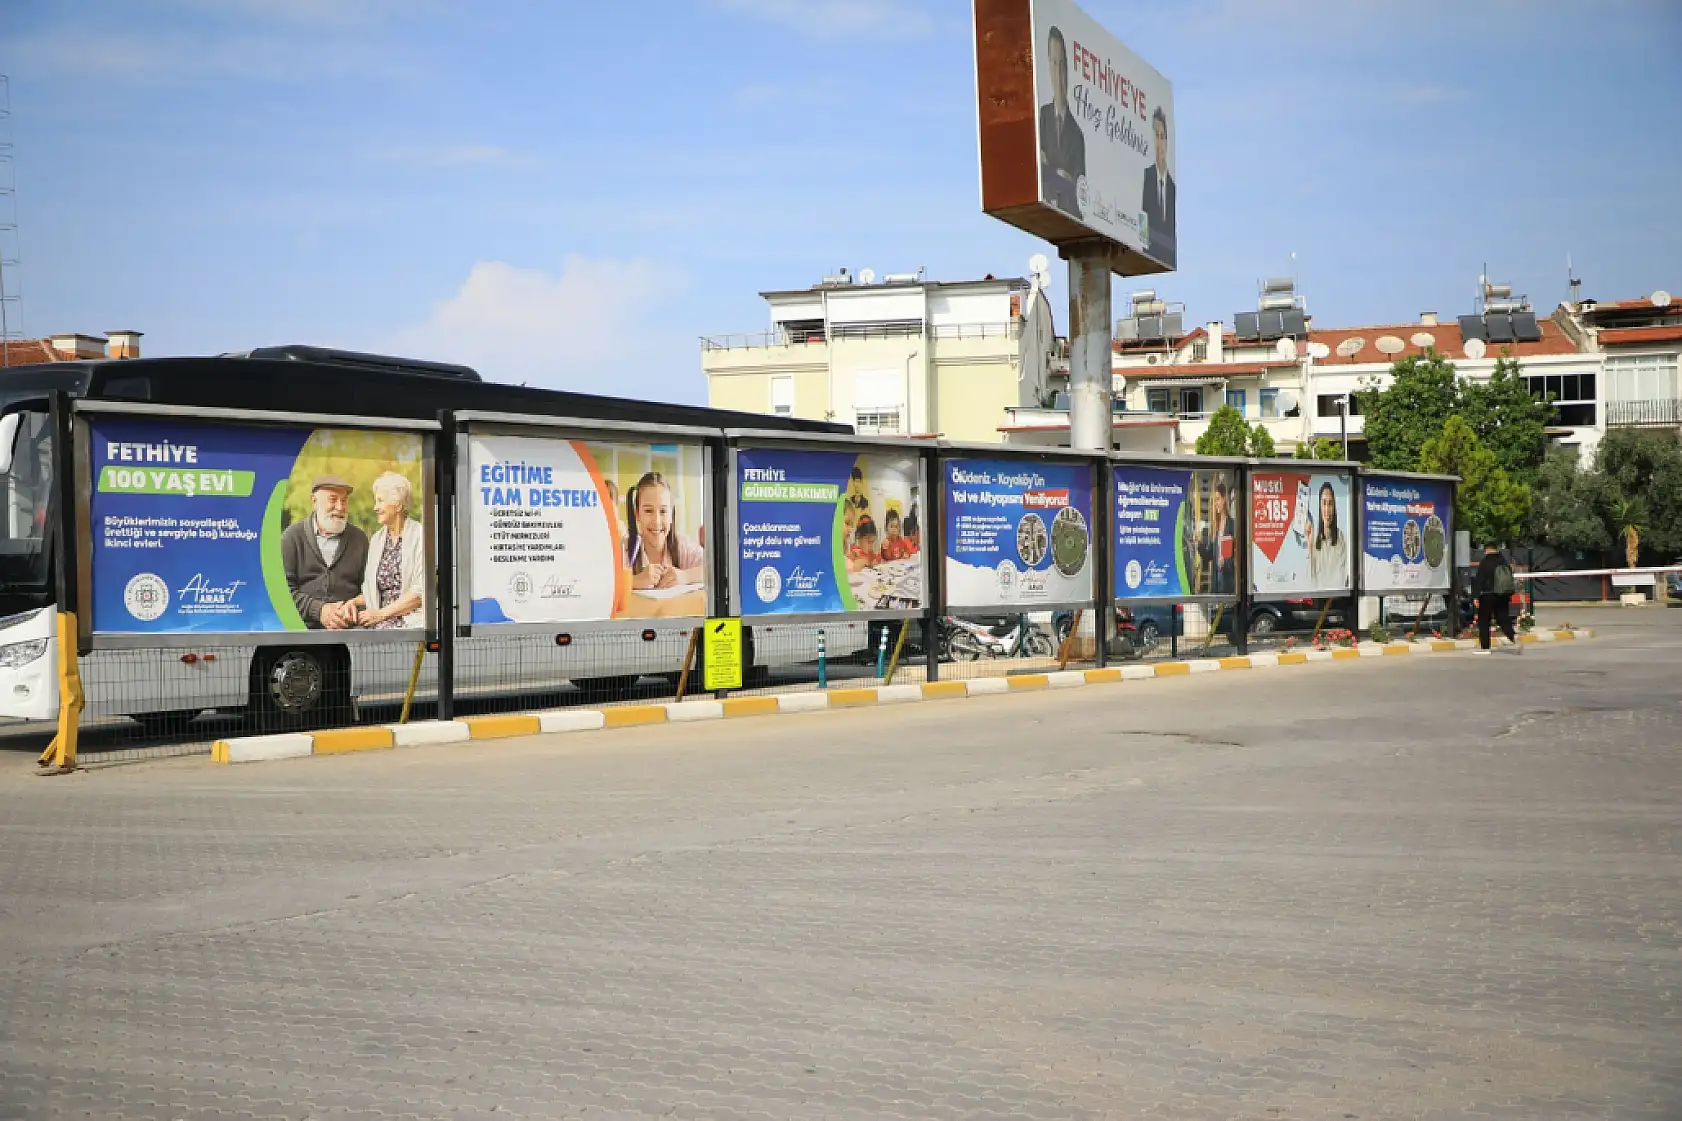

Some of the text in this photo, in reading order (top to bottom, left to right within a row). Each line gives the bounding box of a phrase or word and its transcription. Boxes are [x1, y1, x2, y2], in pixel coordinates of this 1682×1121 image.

[1073, 40, 1147, 121] FETHİYE'YE
[107, 439, 197, 463] FETHİYE
[107, 469, 233, 497] 100 YAŞ EVİ
[480, 461, 553, 485] EĞİTİME
[744, 466, 786, 481] FETHİYE
[481, 487, 598, 507] TAM DESTEK!
[745, 484, 788, 498] GÜNDÜZ
[953, 490, 967, 504] Yol
[1266, 499, 1289, 521] 185
[104, 516, 177, 529] Büyüklerimizin
[158, 529, 197, 539] sevgiyle
[199, 529, 217, 540] bağ
[219, 530, 258, 541] kurduğu
